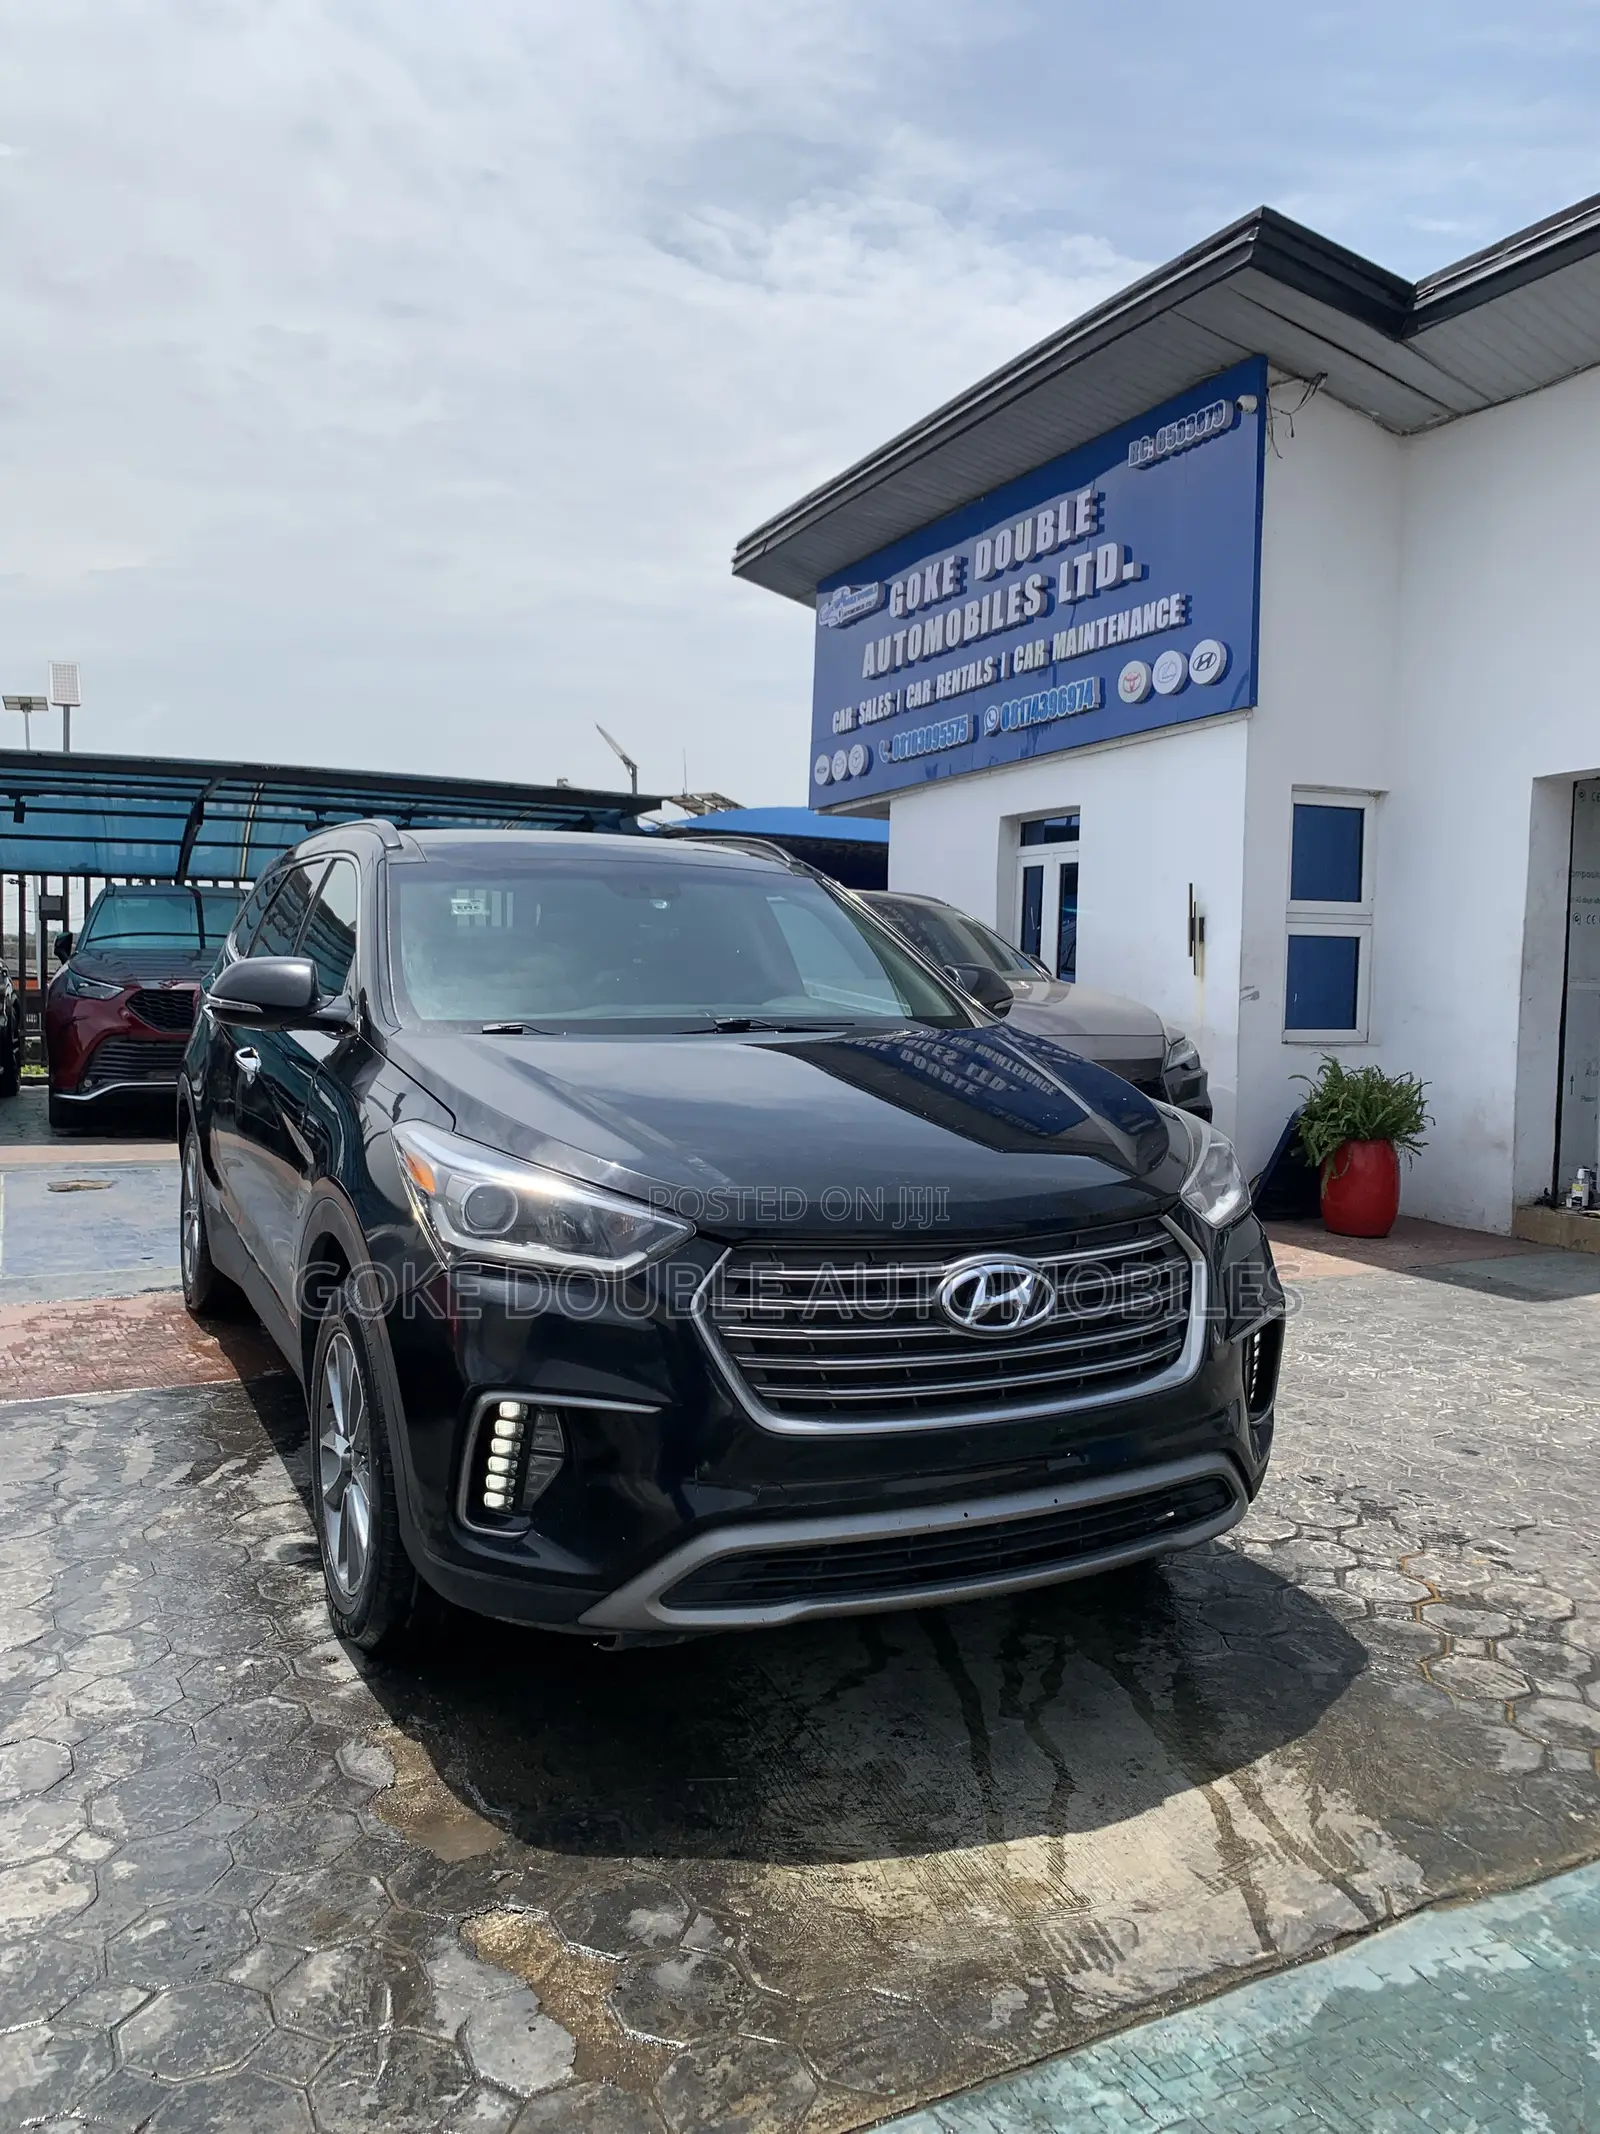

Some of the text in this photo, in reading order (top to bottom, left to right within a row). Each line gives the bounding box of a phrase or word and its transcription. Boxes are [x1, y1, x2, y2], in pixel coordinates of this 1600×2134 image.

[862, 542, 1135, 679] AUTOMOBILES LTD.
[889, 488, 1092, 618] GOKE DOUBLE
[832, 706, 853, 735] CAR
[858, 691, 892, 725] SALES
[906, 679, 931, 709] CAR
[936, 656, 994, 700] RENTALS
[1013, 639, 1045, 674] CAR
[1052, 593, 1181, 661] MAINTENANCE
